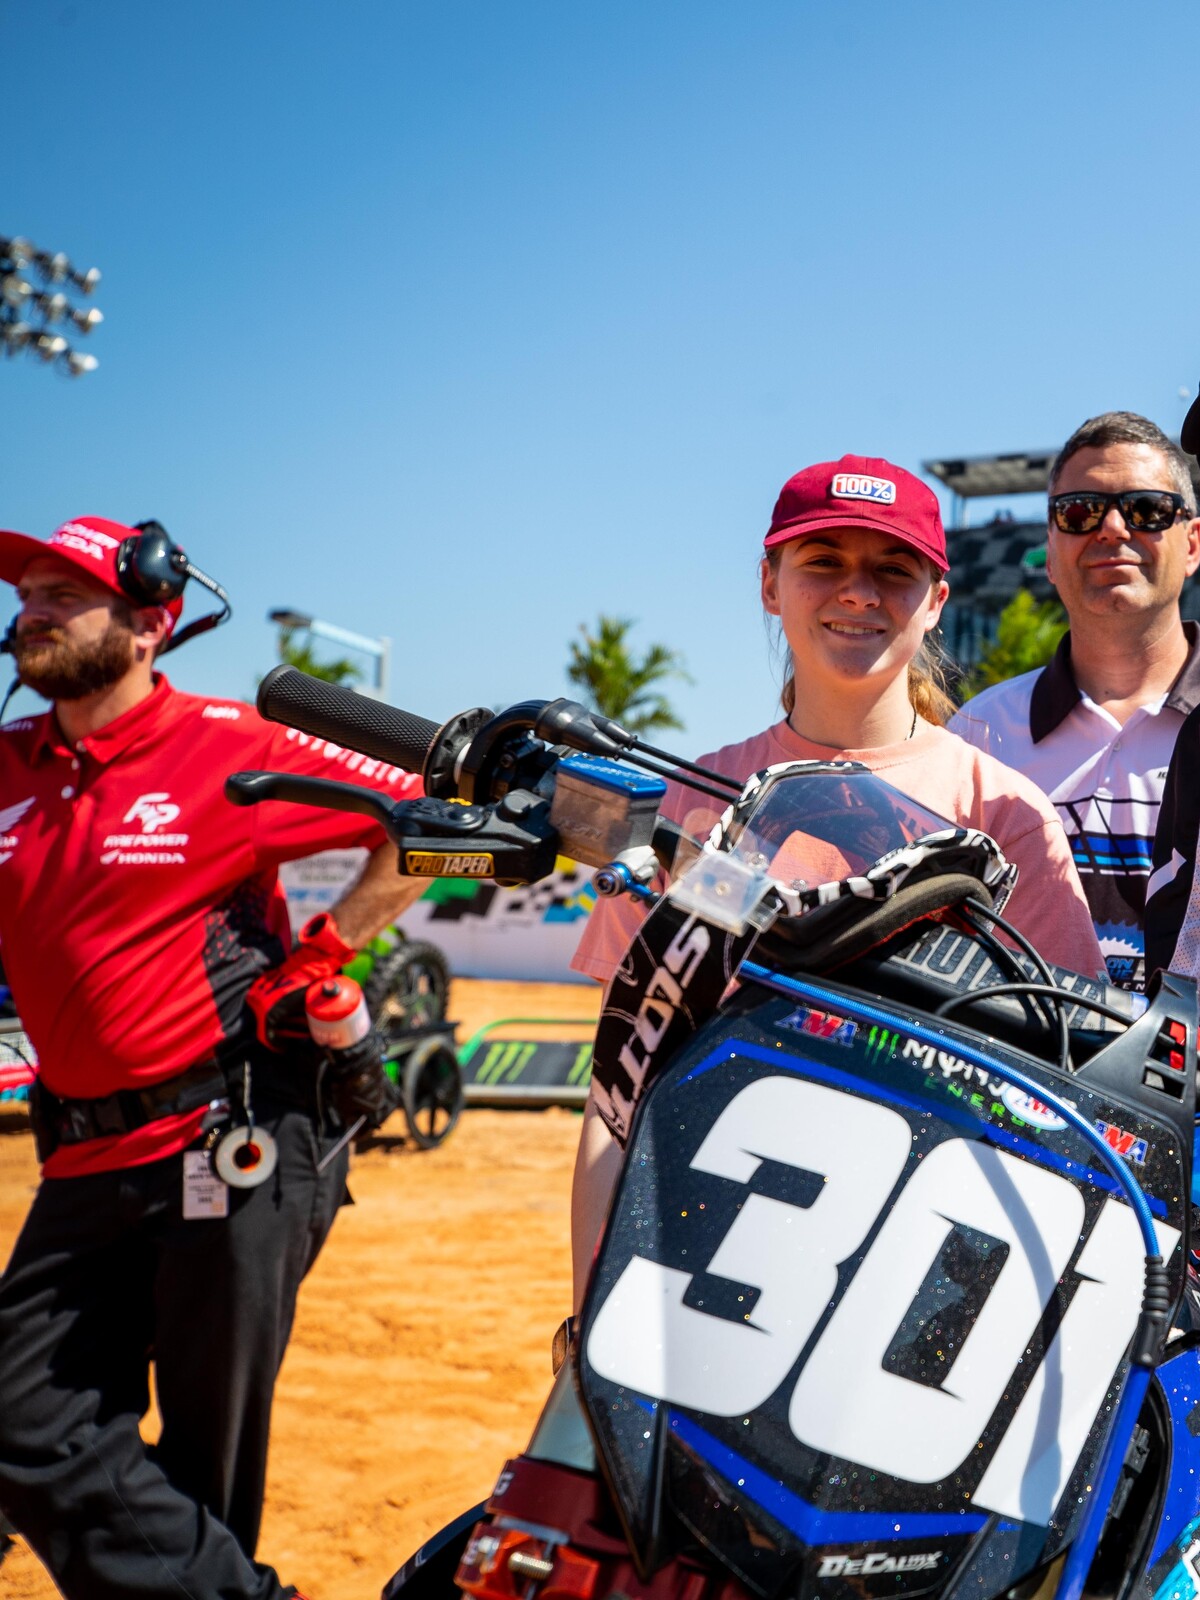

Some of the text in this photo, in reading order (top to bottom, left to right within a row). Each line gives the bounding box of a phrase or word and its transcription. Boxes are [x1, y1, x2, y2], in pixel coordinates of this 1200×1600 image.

[837, 477, 892, 500] 100%
[117, 852, 185, 864] HONDA
[412, 855, 489, 874] PROTAPER
[775, 1006, 858, 1048] AMA
[587, 1076, 1182, 1528] 301
